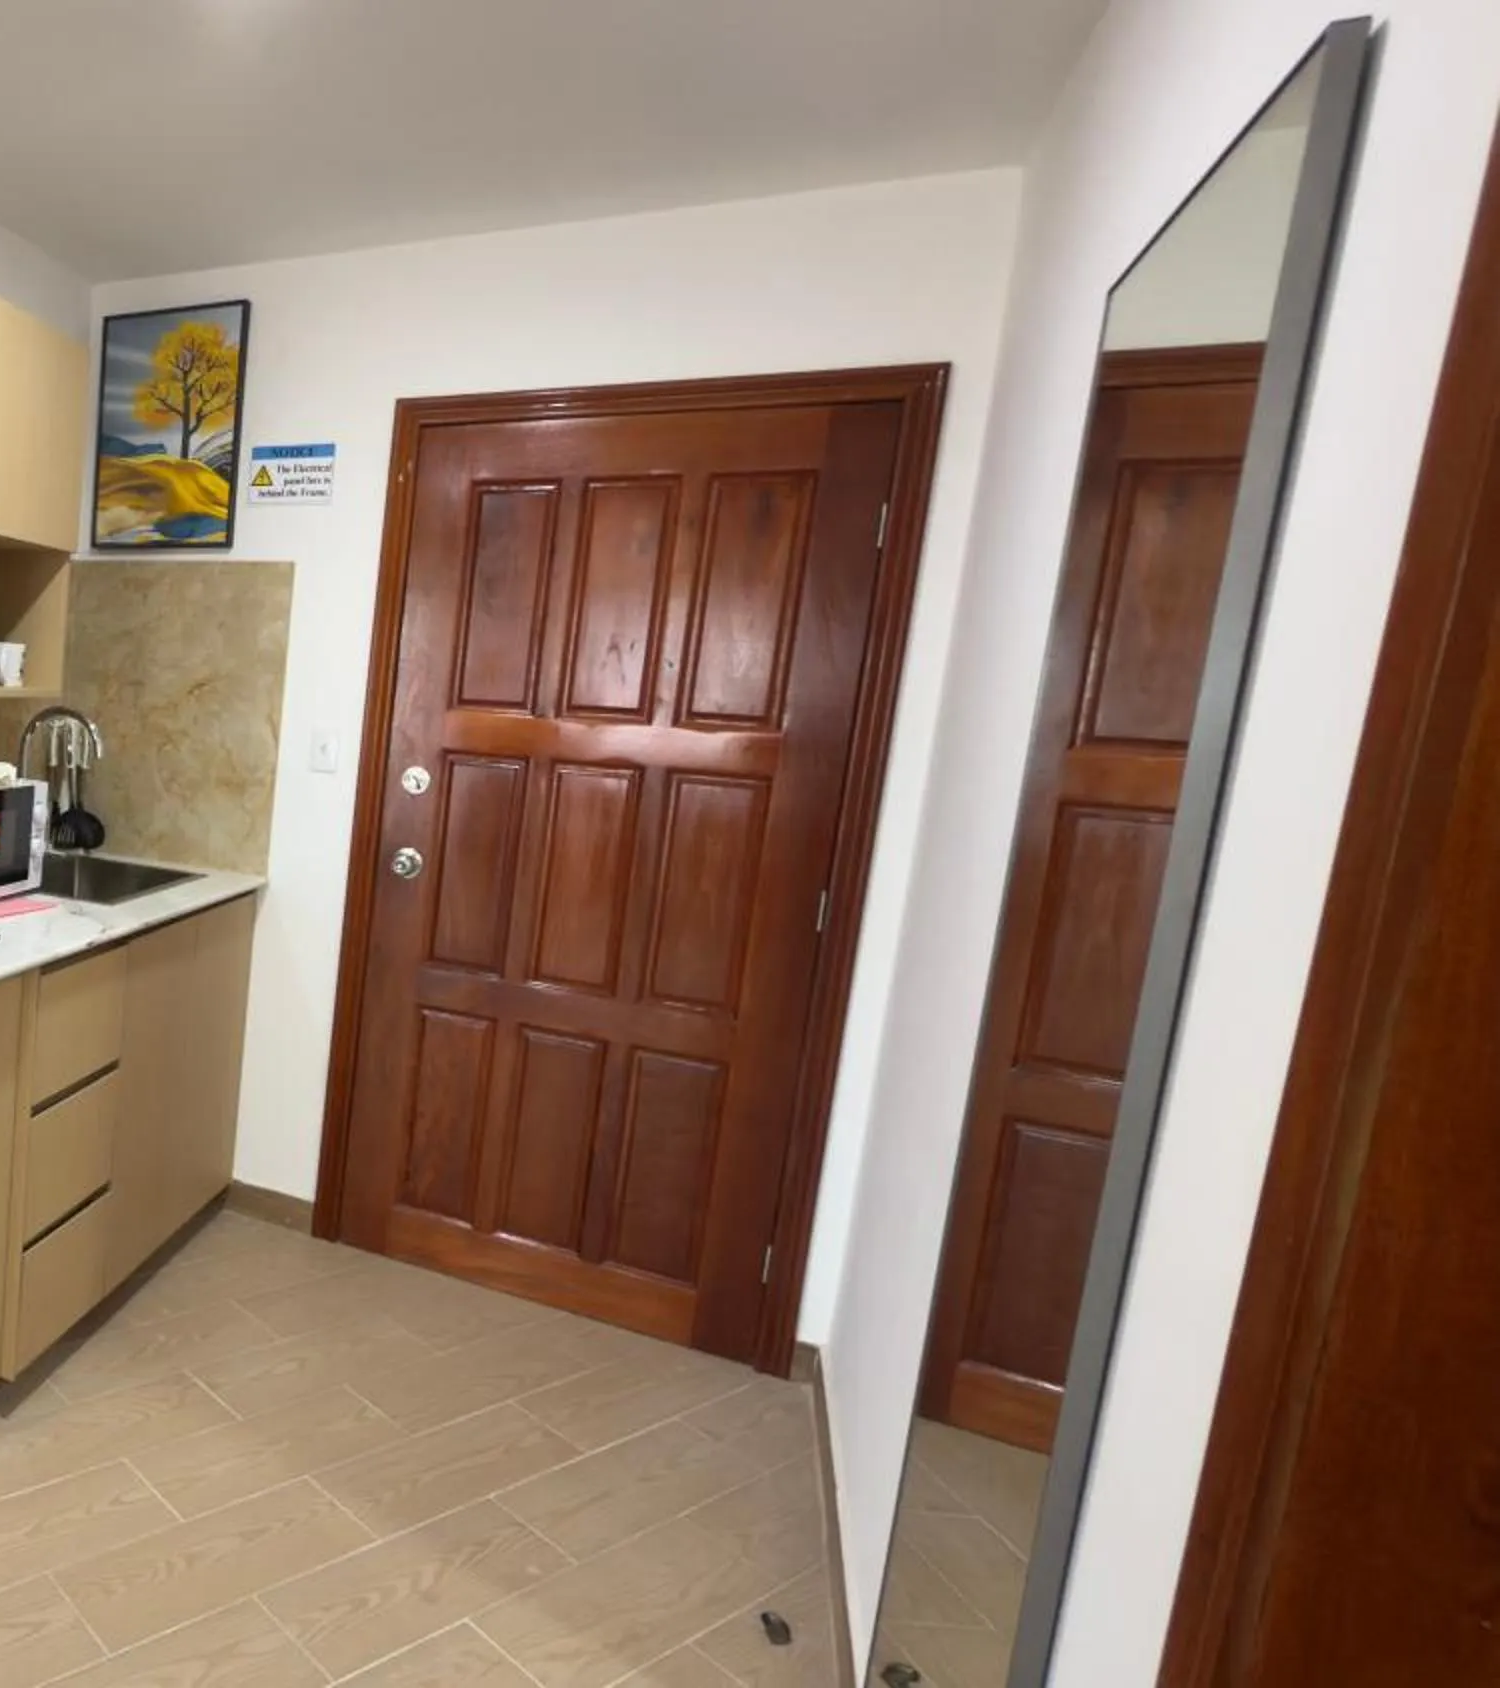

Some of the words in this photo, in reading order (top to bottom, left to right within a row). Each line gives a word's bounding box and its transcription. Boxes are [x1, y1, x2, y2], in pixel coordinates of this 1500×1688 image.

[277, 463, 291, 473] The
[293, 463, 333, 473] Electrical
[283, 477, 305, 487] panel
[258, 488, 284, 497] behind
[286, 488, 297, 497] the
